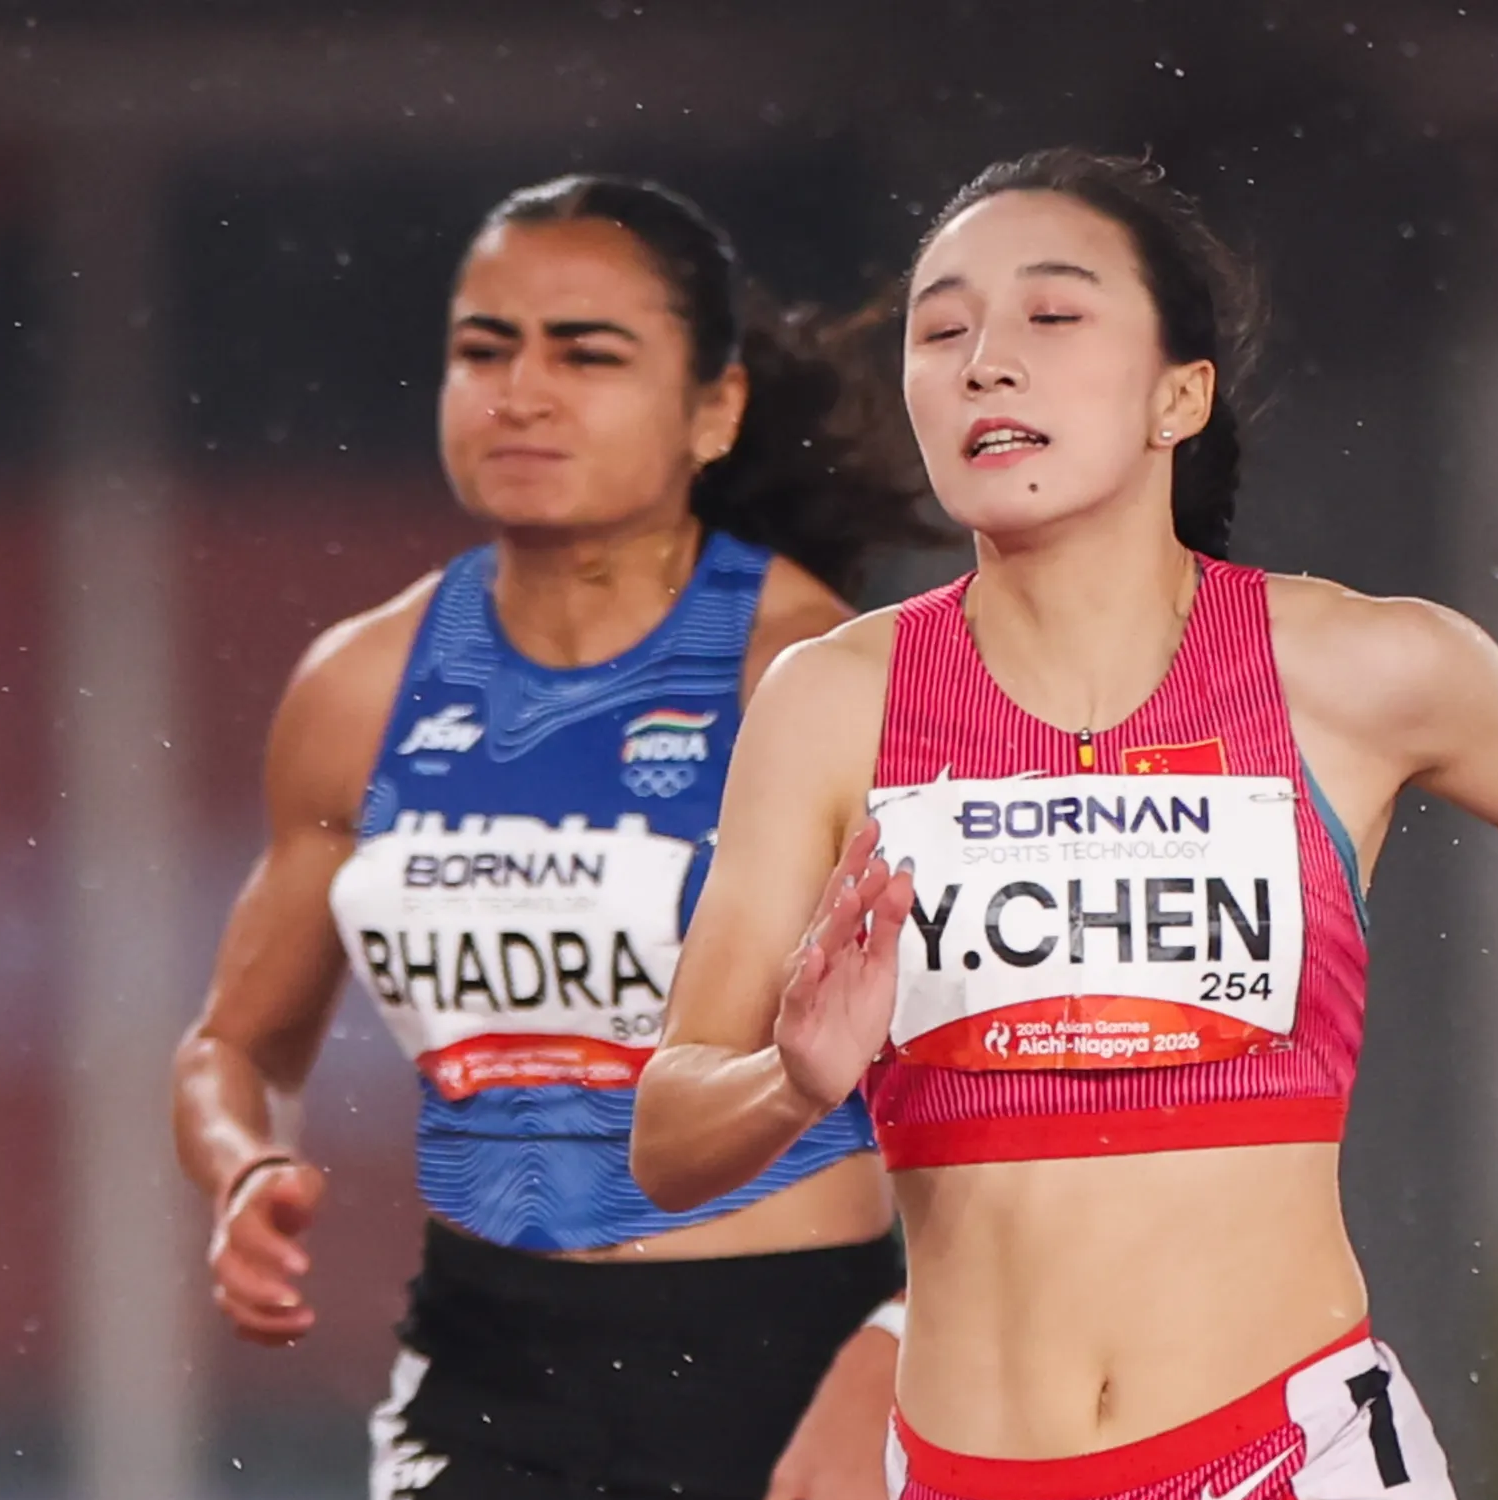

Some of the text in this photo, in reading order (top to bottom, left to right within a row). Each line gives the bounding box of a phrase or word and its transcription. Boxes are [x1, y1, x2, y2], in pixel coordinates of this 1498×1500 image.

[953, 795, 1210, 839] BORNAN
[962, 840, 1210, 865] SPORTS TECHNOLOGY
[404, 853, 605, 888] BORNAN
[910, 877, 1271, 971] Y.CHEN
[360, 930, 665, 1012] BHADRA
[1200, 972, 1273, 1001] 254
[1016, 1020, 1150, 1036] 20th Asian Games
[1017, 1032, 1200, 1058] Aichi-Nagoya 2026
